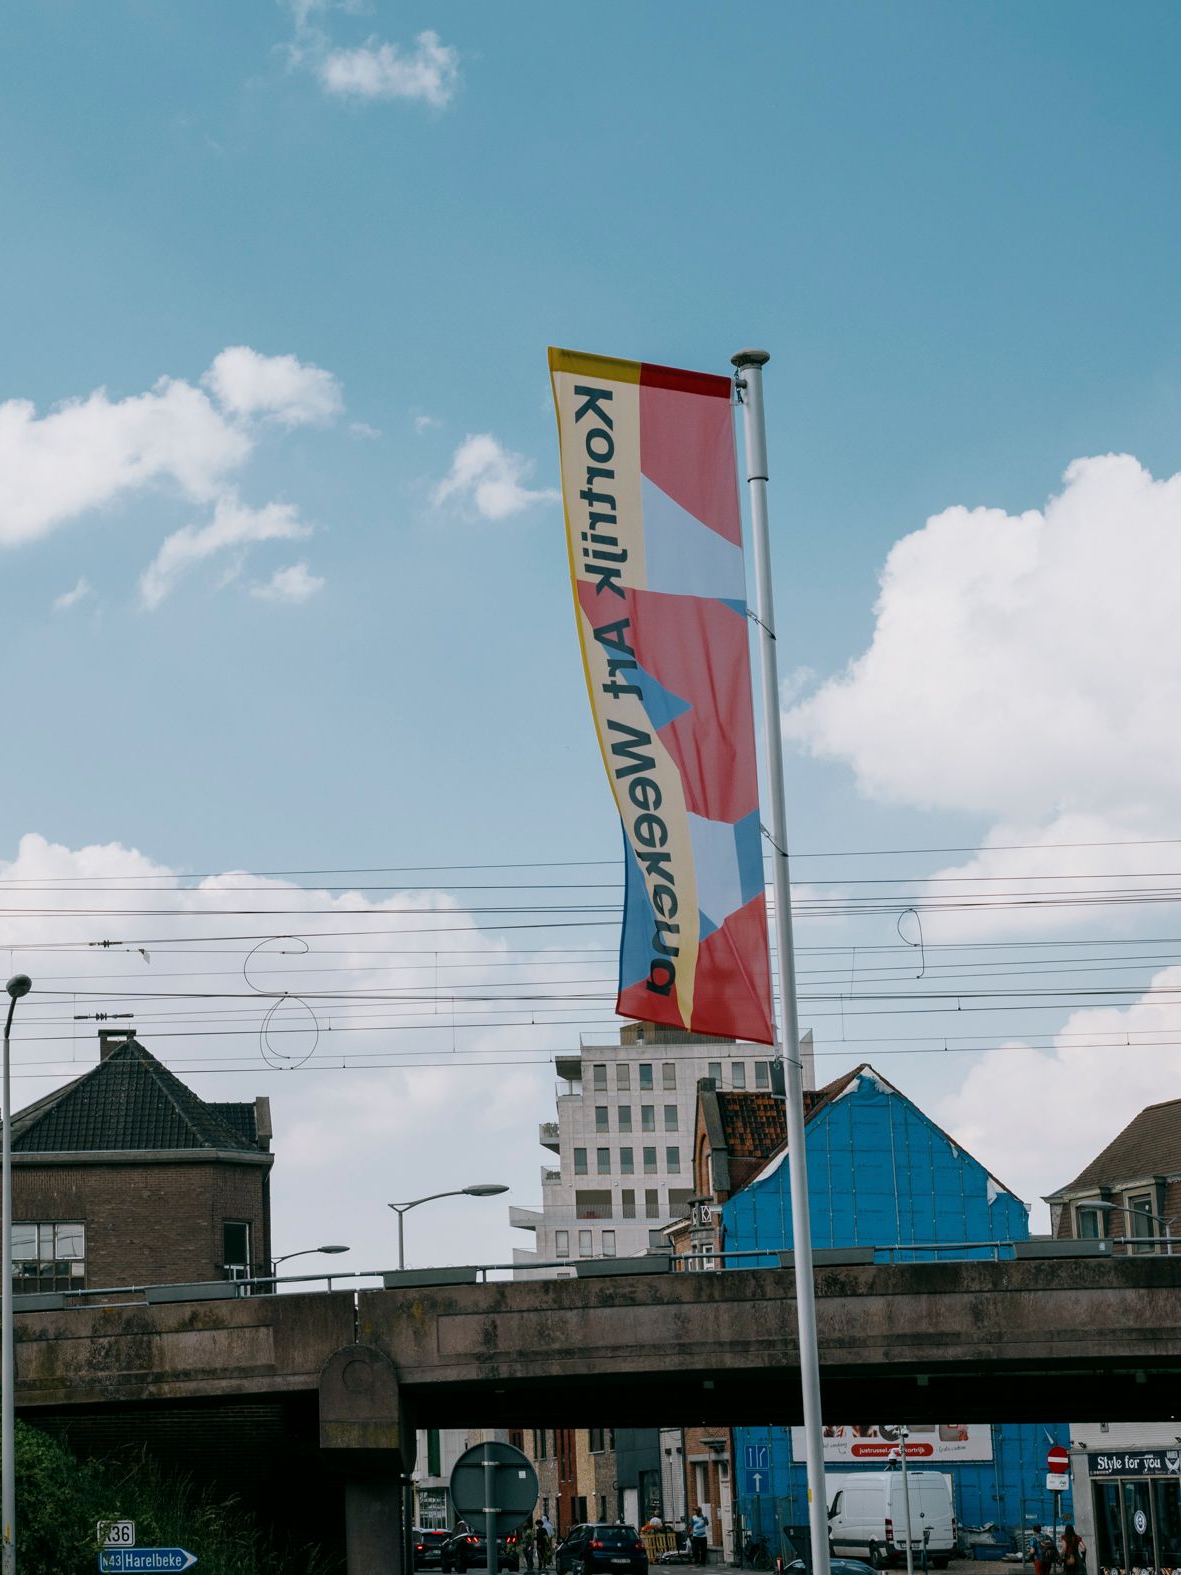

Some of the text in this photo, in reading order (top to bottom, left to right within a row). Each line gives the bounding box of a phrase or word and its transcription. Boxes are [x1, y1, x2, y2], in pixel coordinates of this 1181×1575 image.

[1097, 1455, 1162, 1473] Style for you
[104, 1525, 130, 1542] 36
[125, 1552, 182, 1567] Harelbeke
